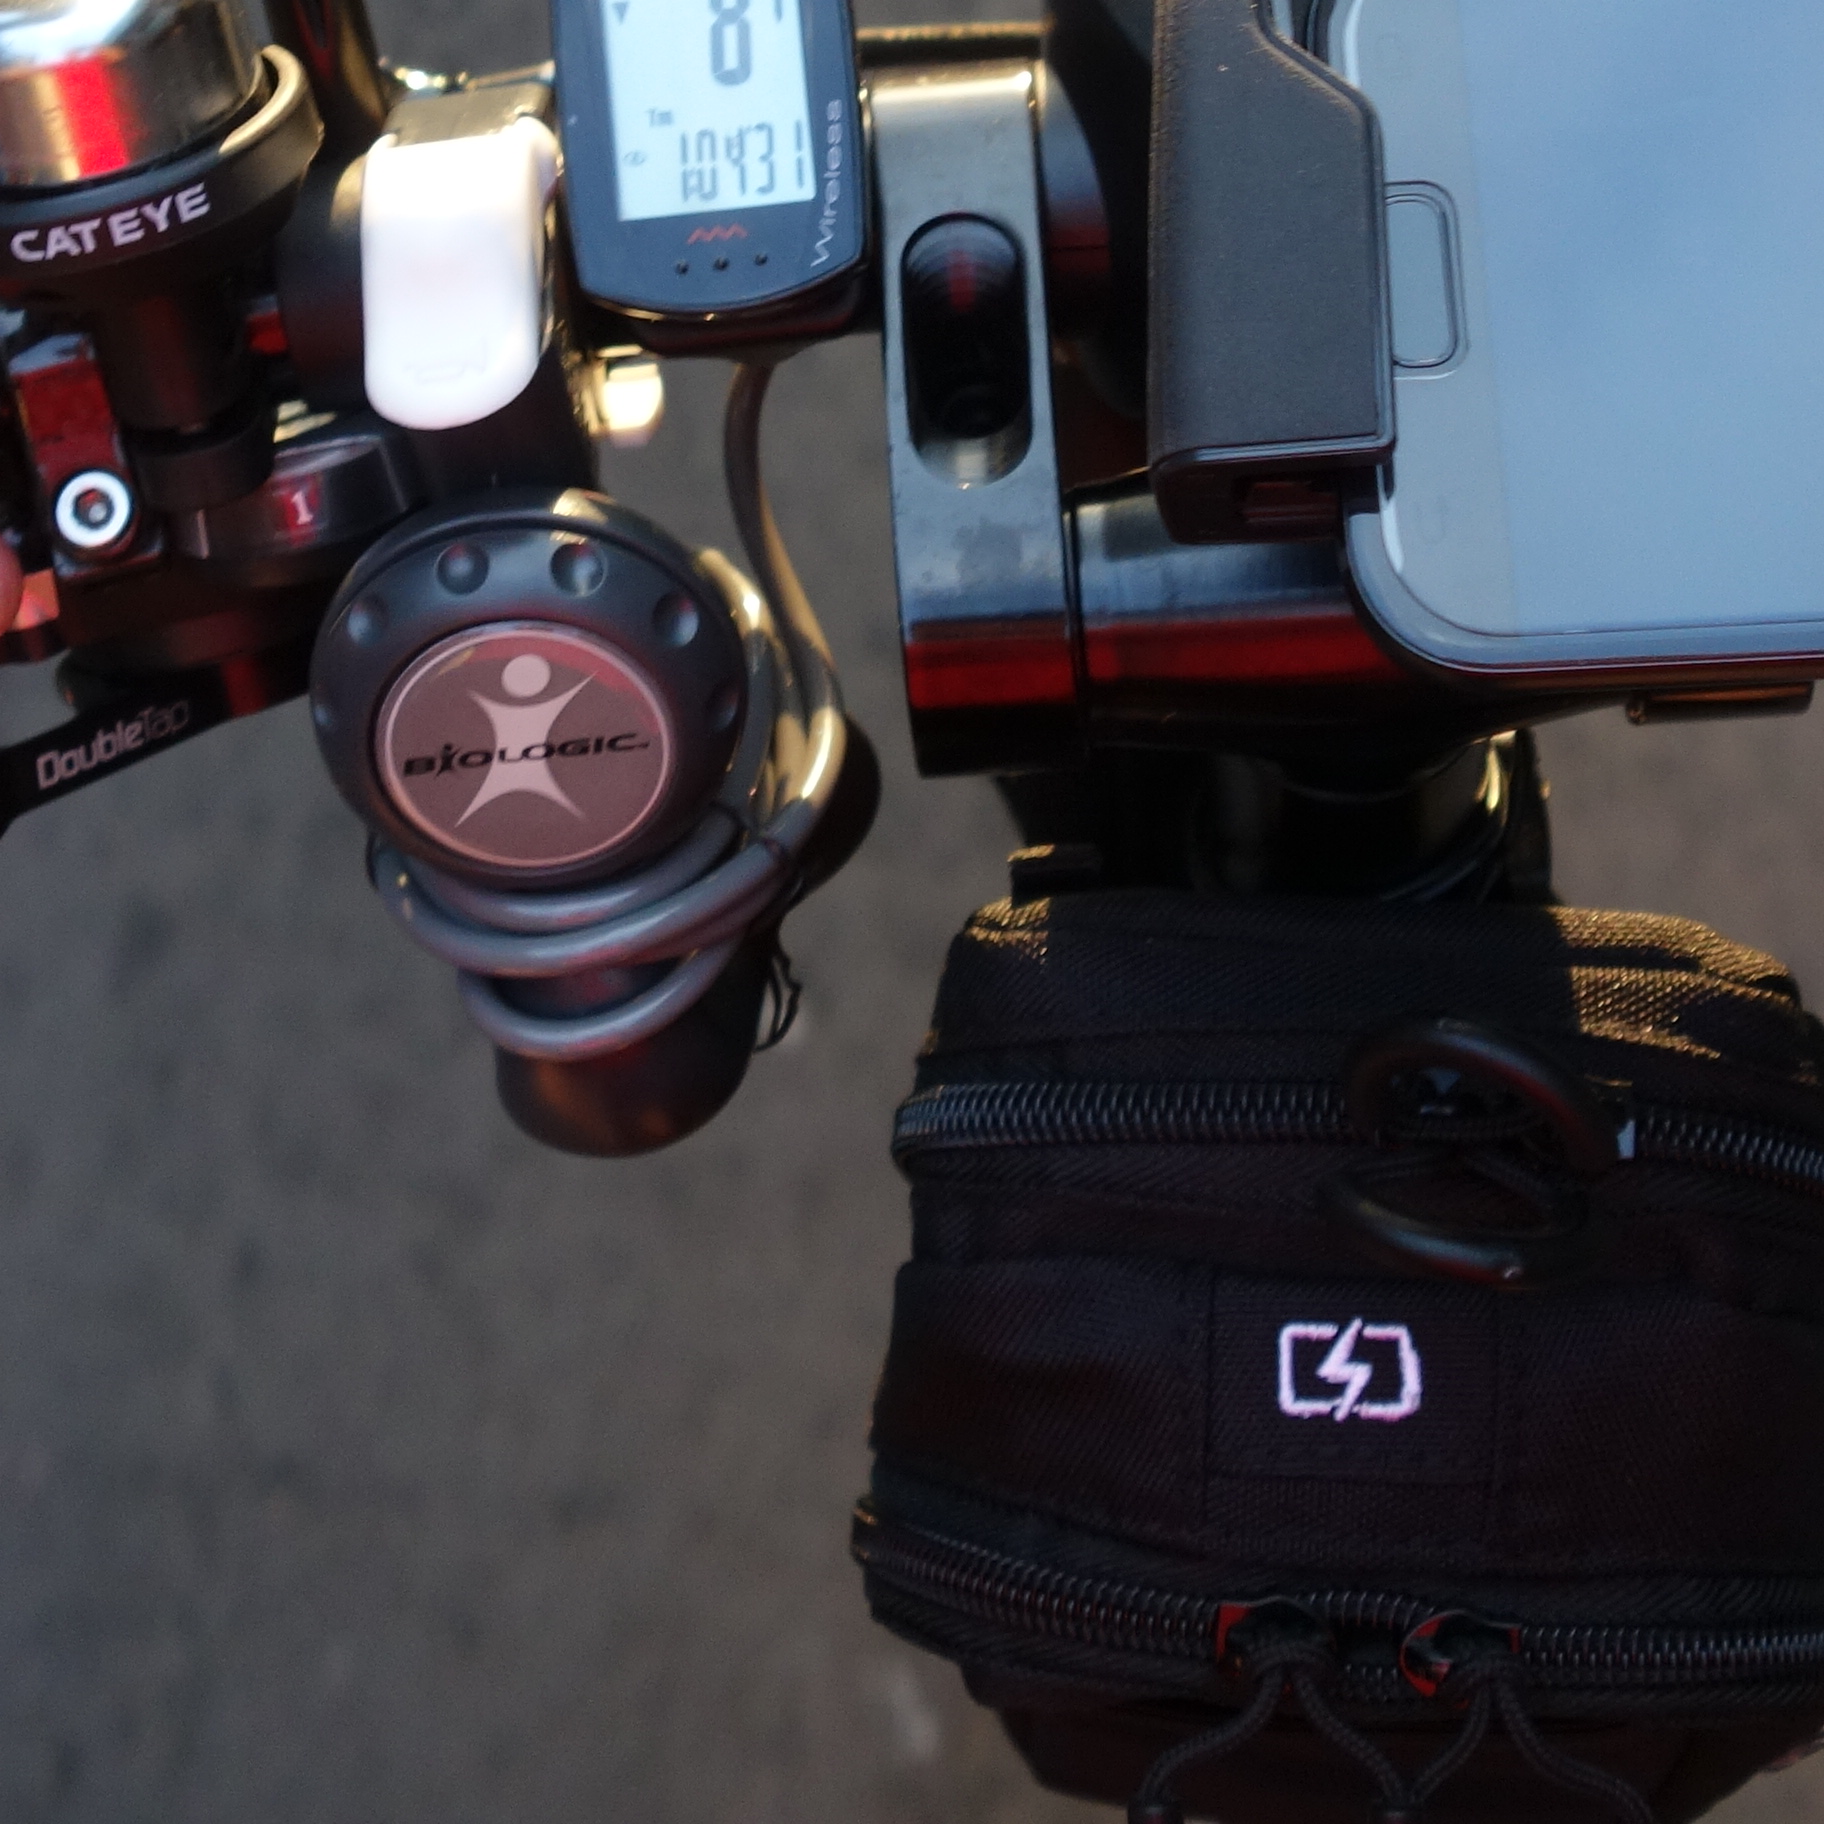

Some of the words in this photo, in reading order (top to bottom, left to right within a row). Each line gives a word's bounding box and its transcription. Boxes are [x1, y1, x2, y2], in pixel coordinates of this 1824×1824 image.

[10, 182, 212, 263] CATEYE
[811, 99, 843, 267] Wireless
[291, 491, 313, 525] 1
